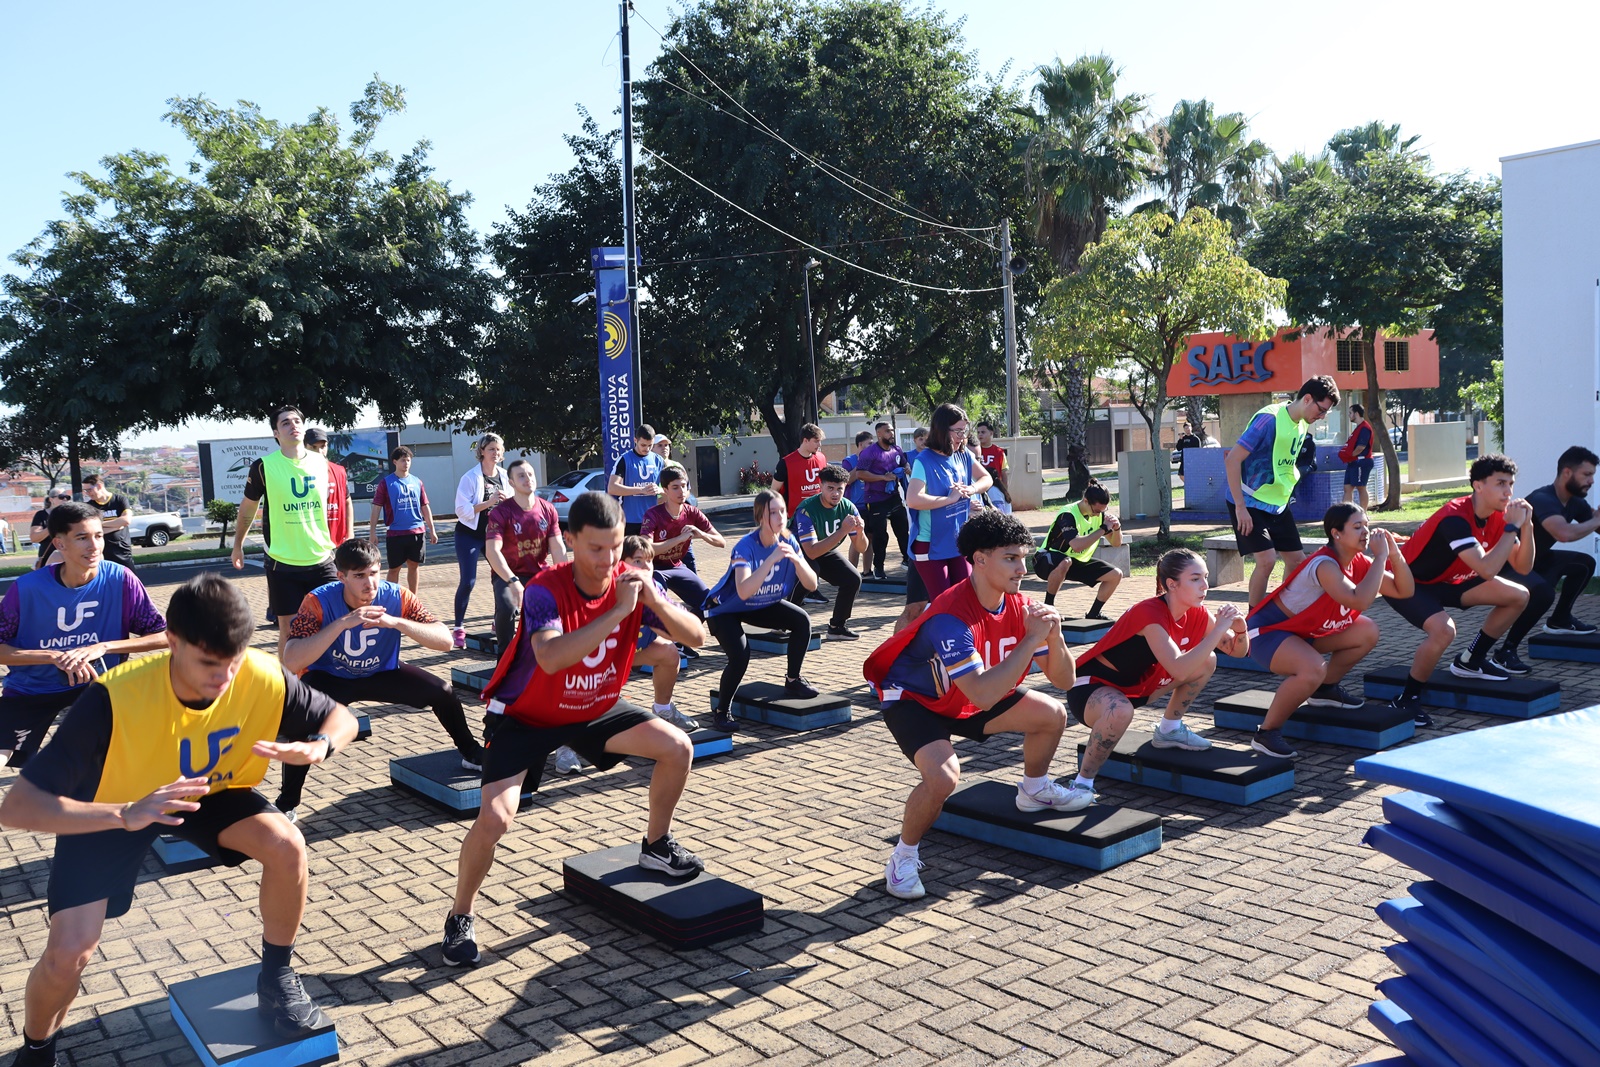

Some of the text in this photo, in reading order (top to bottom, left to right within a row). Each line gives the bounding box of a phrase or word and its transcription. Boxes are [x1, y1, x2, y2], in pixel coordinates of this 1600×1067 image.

[1187, 341, 1274, 380] SAEC
[608, 374, 620, 461] CATANDUVA
[617, 372, 631, 449] SEGURA
[226, 444, 269, 453] TRANQUILIDADE
[638, 464, 656, 480] UF
[805, 467, 820, 483] UF
[290, 475, 317, 499] UF
[283, 500, 321, 512] UNIFIPA
[752, 583, 785, 597] NIFIPA
[57, 600, 99, 632] UF
[39, 632, 99, 649] UNIFIPA
[345, 627, 380, 657] UF
[941, 639, 956, 652] UF
[332, 649, 380, 668] UNIFIPA
[180, 726, 241, 779] UF
